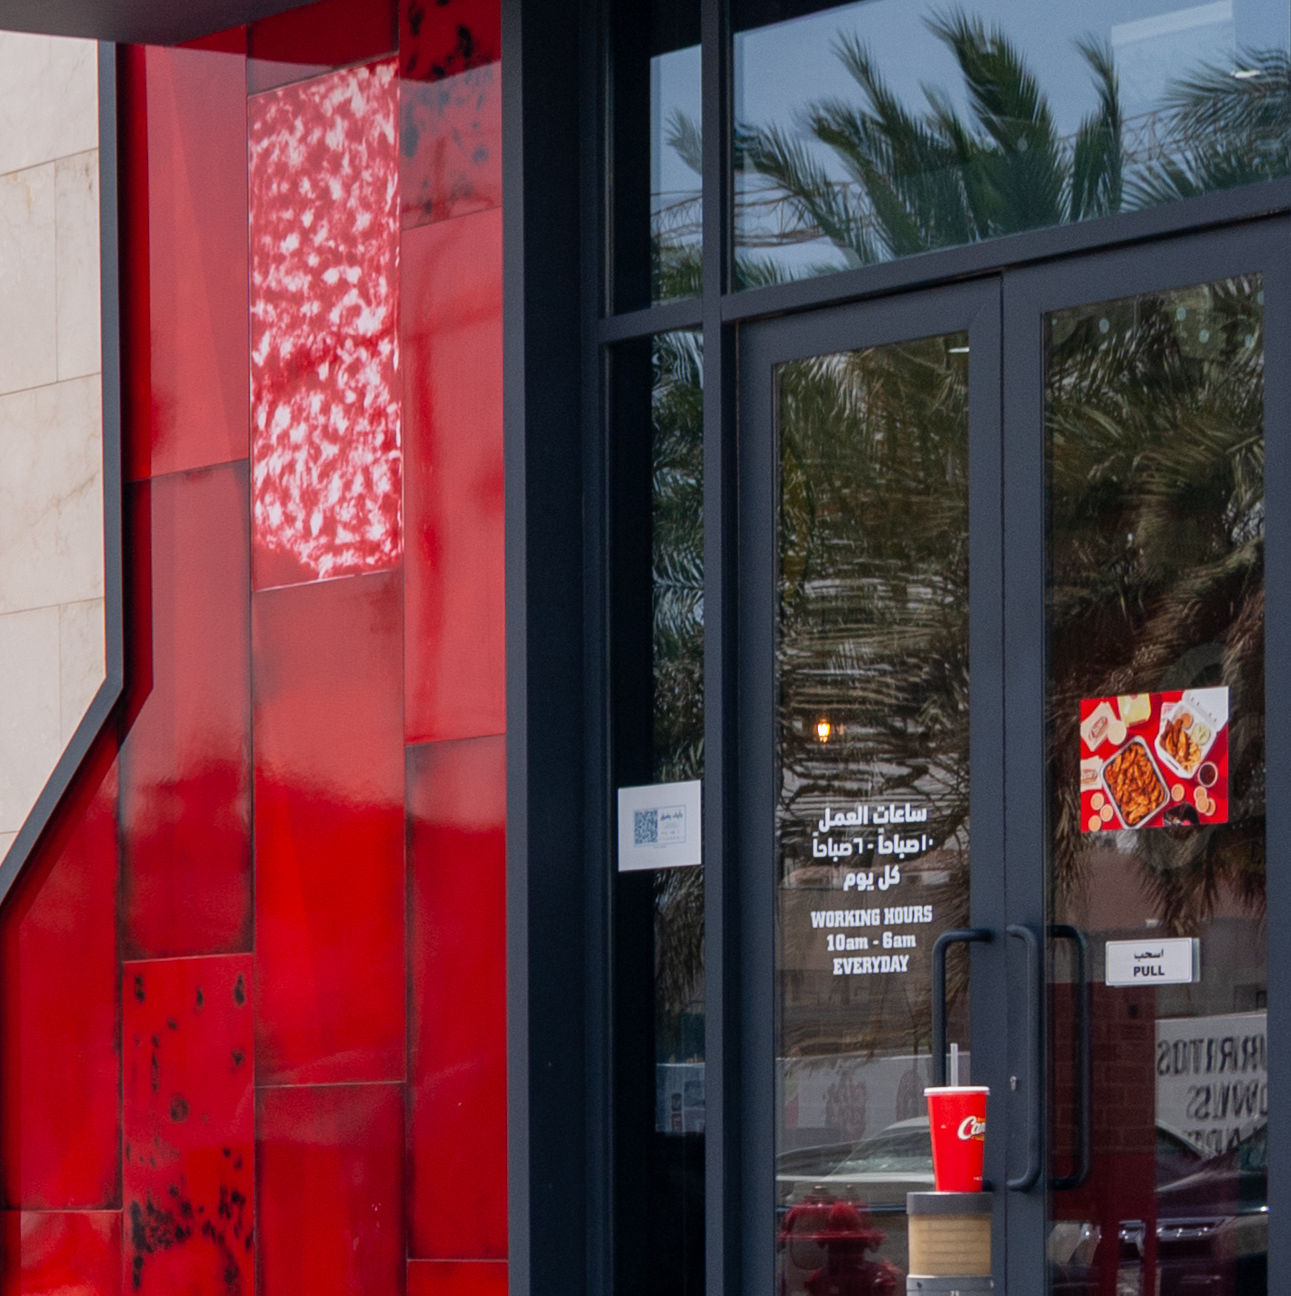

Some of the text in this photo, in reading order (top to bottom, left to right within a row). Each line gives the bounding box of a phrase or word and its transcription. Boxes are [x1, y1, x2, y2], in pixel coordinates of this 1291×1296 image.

[819, 803, 927, 833] ساعات العمل
[843, 864, 901, 892] كل يوم
[810, 905, 933, 928] WORKING HOURS
[826, 934, 869, 951] 10am
[882, 931, 917, 948] 6am
[833, 954, 910, 975] EVERYDAY
[1134, 948, 1164, 963] اسحب
[1133, 965, 1165, 977] PULL
